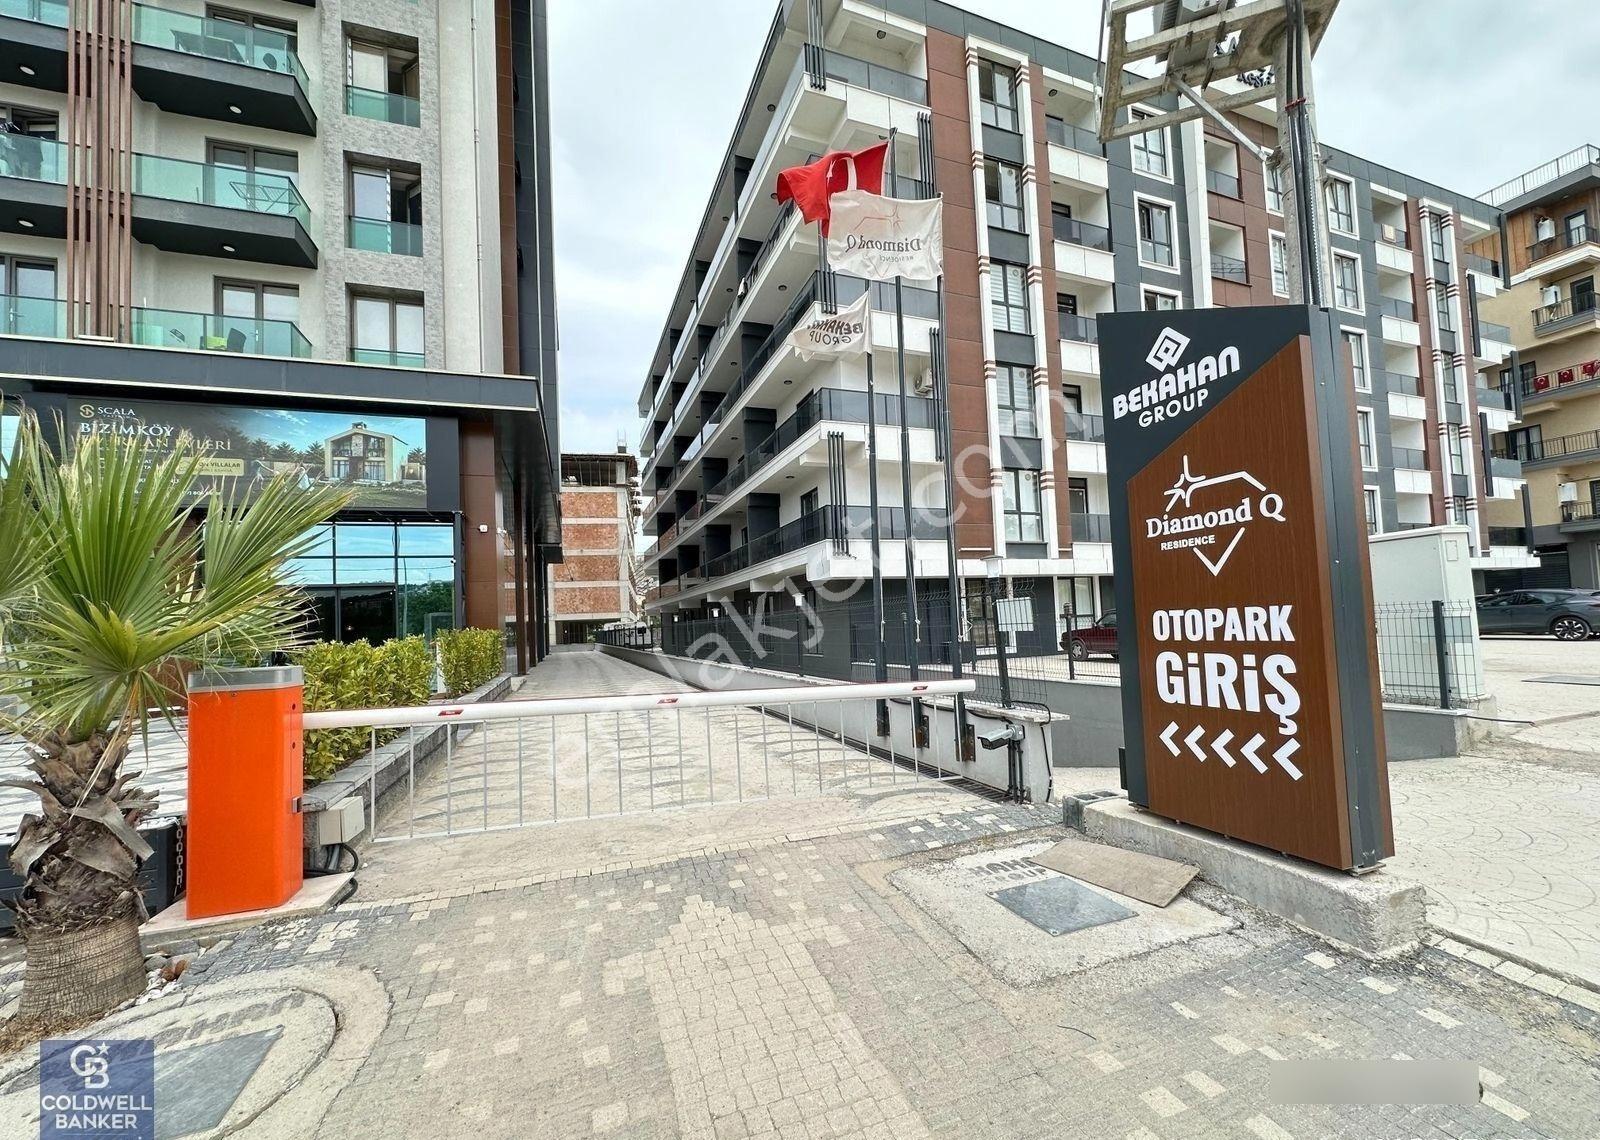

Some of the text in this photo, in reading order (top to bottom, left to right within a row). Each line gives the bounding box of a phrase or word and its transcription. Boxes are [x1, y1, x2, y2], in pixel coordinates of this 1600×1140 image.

[1113, 346, 1240, 420] BEKAHAN
[97, 406, 136, 416] SCALA
[1138, 388, 1209, 428] GROUP
[1146, 493, 1286, 538] Diamond Q
[1160, 534, 1216, 551] RESIDENCE
[1152, 604, 1295, 642] OTOPARK
